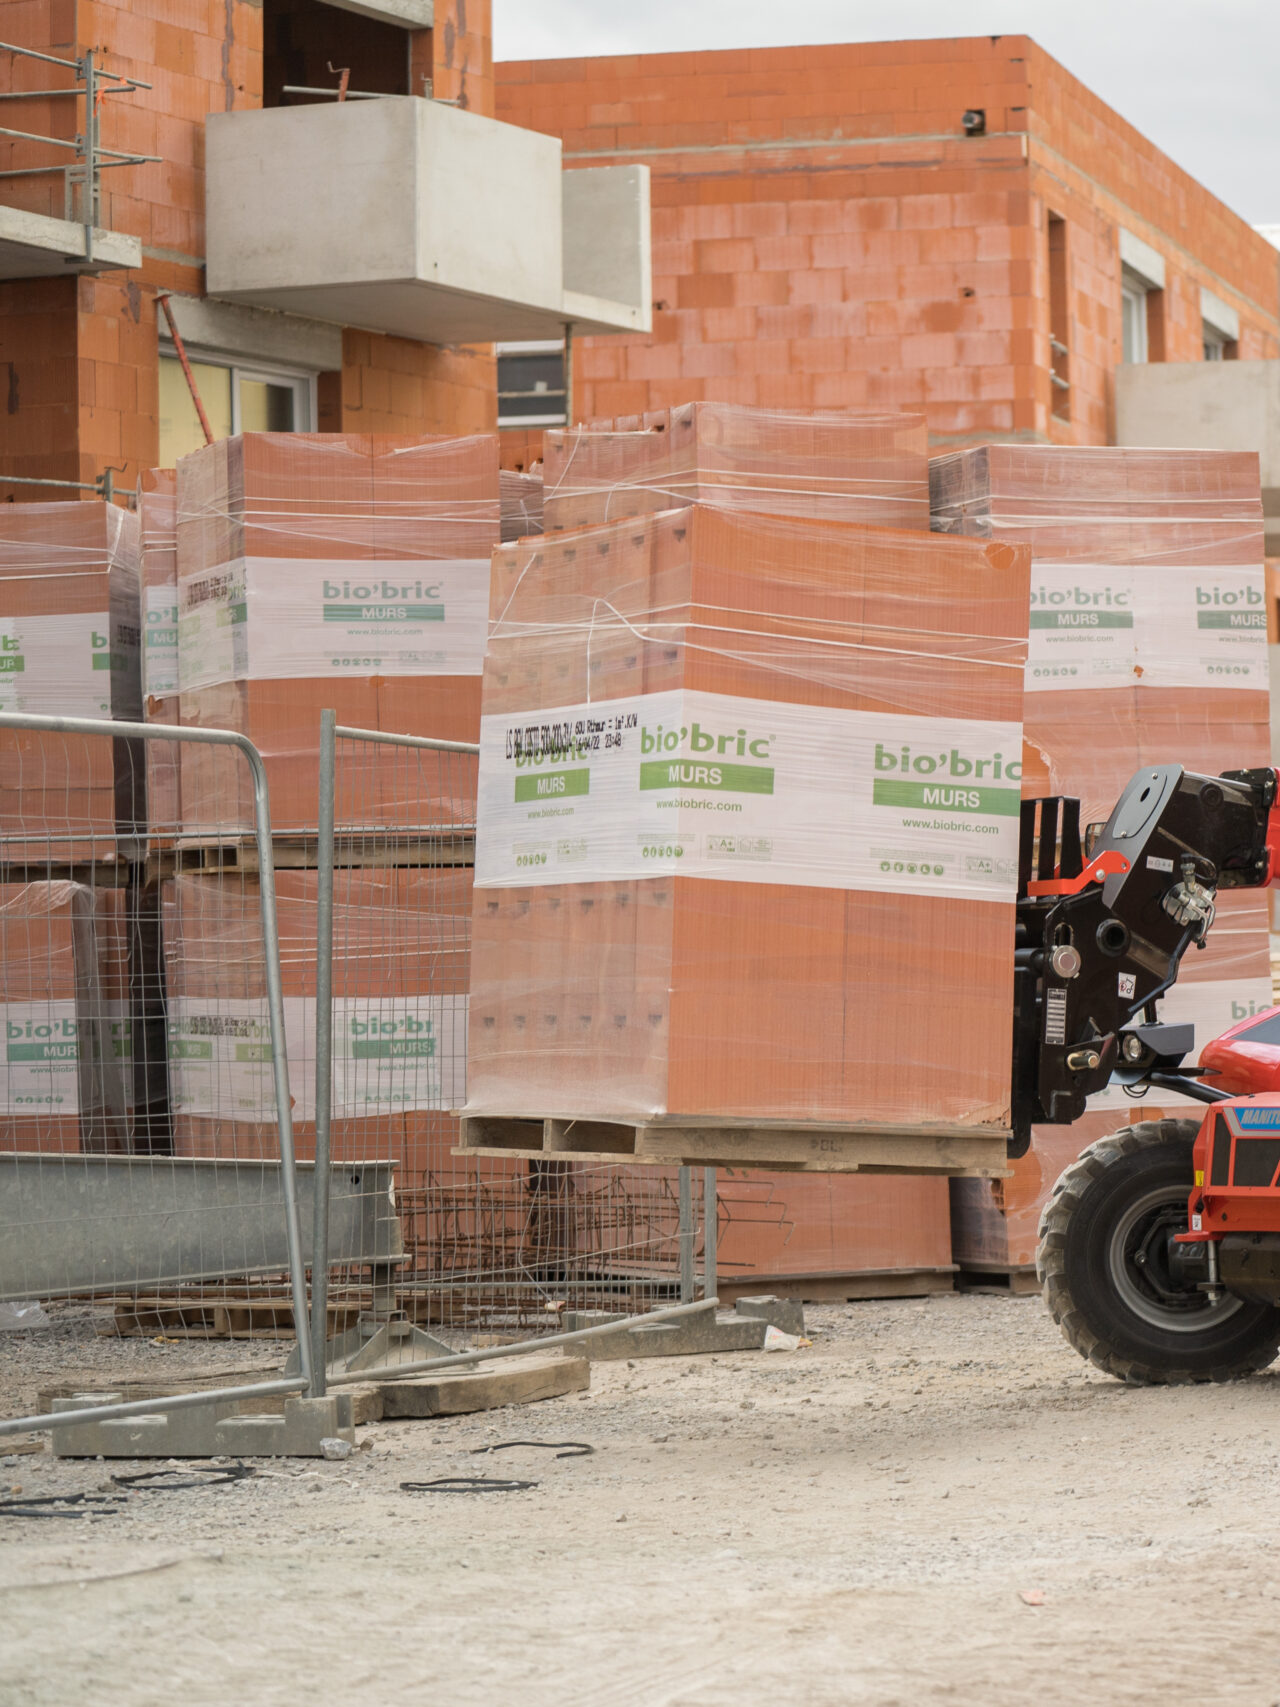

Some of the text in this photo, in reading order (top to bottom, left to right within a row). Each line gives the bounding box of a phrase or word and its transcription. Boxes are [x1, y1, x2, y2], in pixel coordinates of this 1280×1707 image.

[1195, 586, 1266, 605] bio'b
[361, 607, 408, 619] MURS
[1057, 613, 1100, 625] MURS
[641, 722, 773, 759] bio'bric
[874, 743, 1022, 782] bio'bric
[668, 764, 723, 786] MURS
[537, 776, 566, 795] MURS
[656, 798, 743, 813] www.biobric.com
[922, 787, 982, 809] MURS
[527, 807, 576, 820] www.biobric.com
[902, 818, 1000, 835] www.biobric.com
